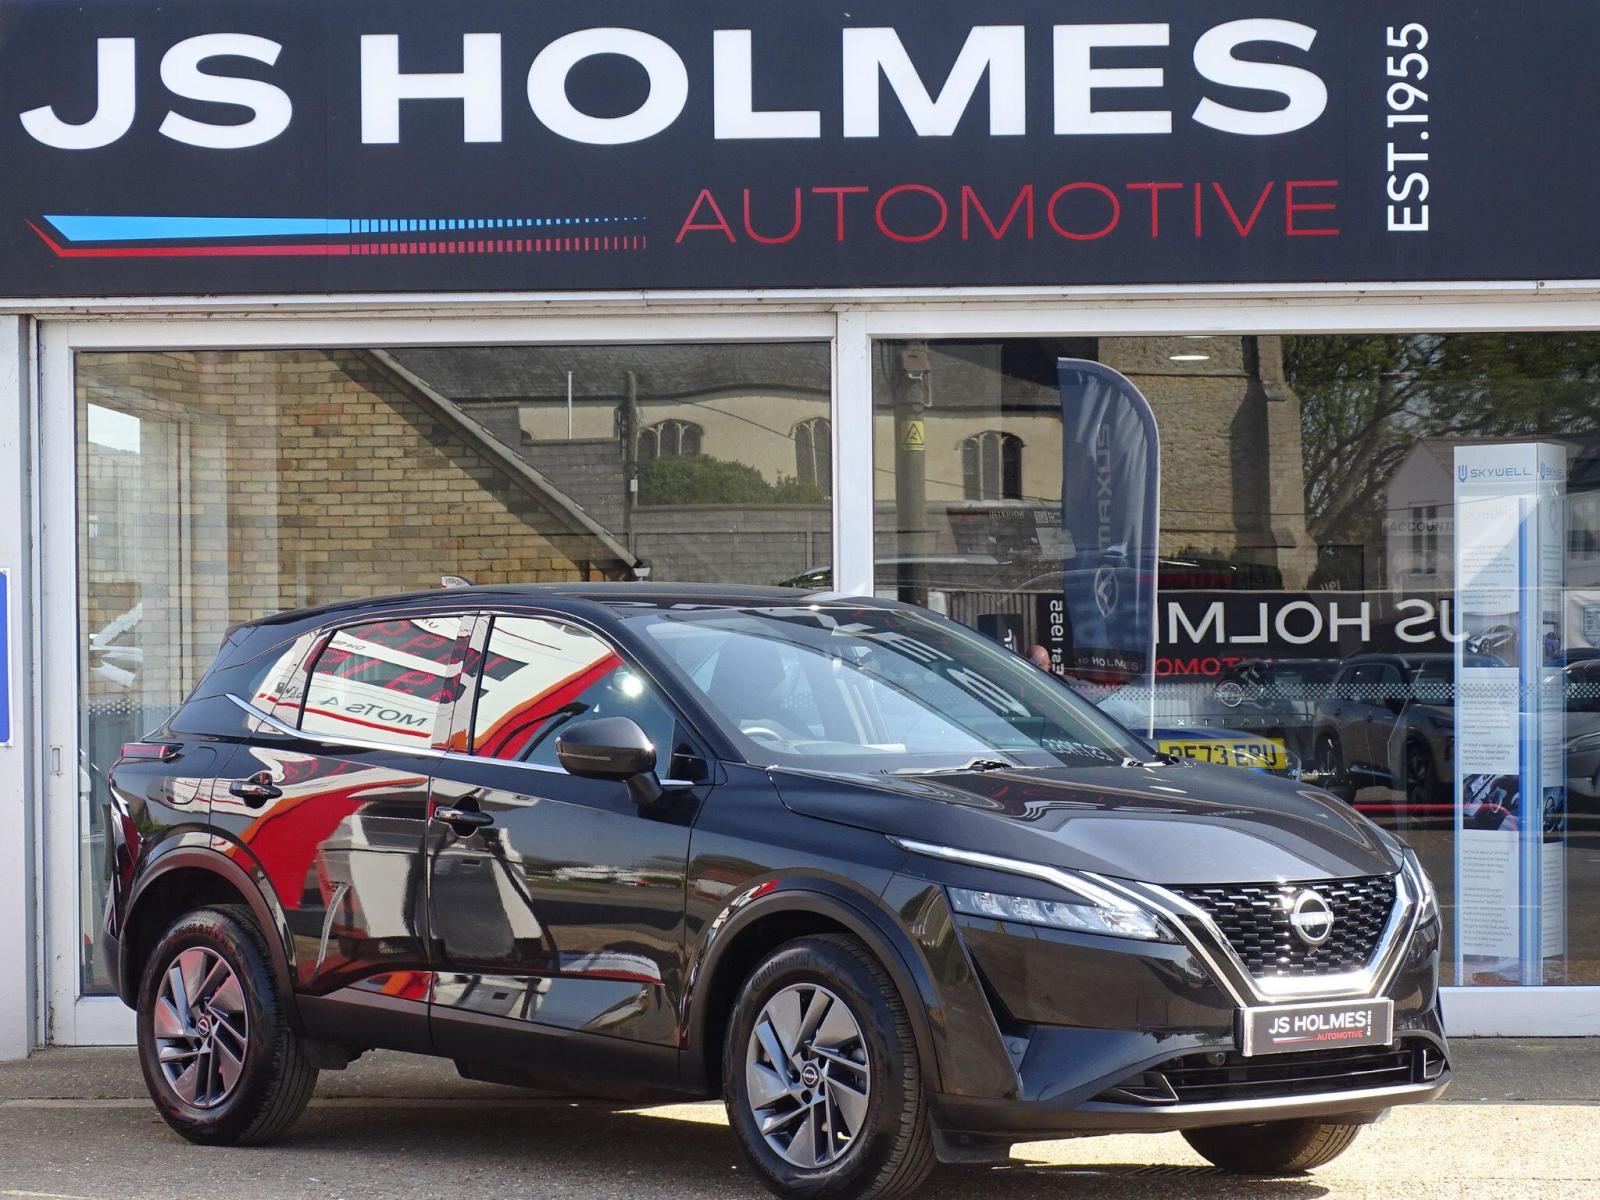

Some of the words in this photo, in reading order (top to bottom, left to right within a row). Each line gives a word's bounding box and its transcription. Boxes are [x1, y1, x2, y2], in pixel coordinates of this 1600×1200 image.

[19, 33, 292, 149] JS
[360, 18, 1328, 145] HOLMES
[1387, 22, 1429, 232] EST.1955
[675, 180, 1340, 244] AUTOMOTIVE
[1470, 466, 1531, 478] SKYWELL
[1389, 520, 1455, 532] ACCOUNT
[1269, 1015, 1290, 1034] JS
[1294, 1010, 1367, 1031] HOLMES
[1316, 1030, 1363, 1041] AUTOMOTIVE
